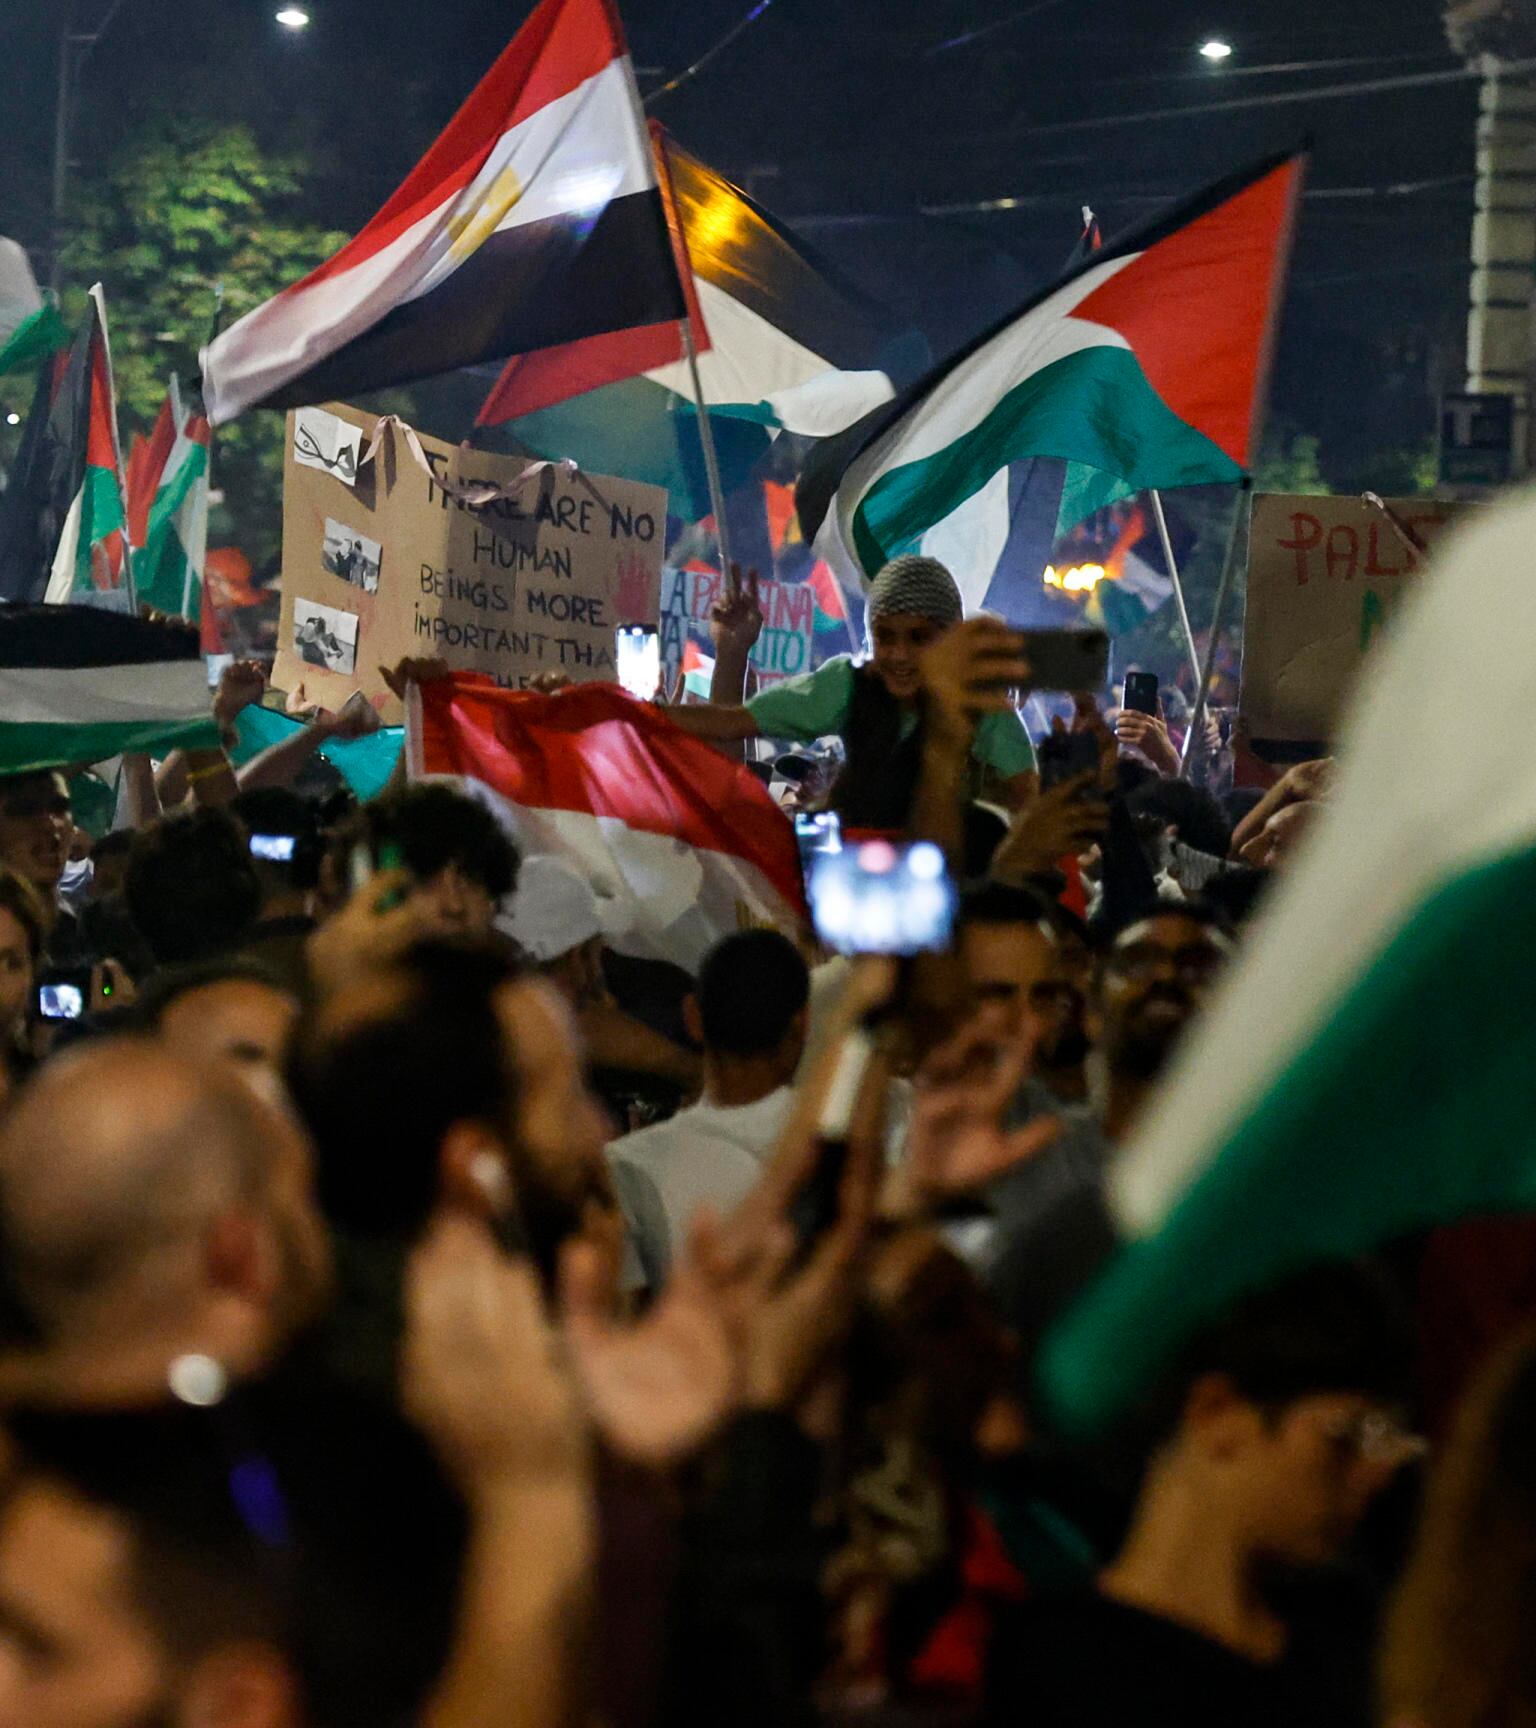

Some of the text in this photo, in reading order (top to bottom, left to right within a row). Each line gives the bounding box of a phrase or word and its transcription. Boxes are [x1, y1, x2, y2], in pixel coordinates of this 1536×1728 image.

[534, 492, 595, 535] ARE
[609, 503, 656, 542] NO
[473, 530, 572, 579] HUMAN
[527, 589, 608, 627] MORE
[555, 638, 618, 672] THA
